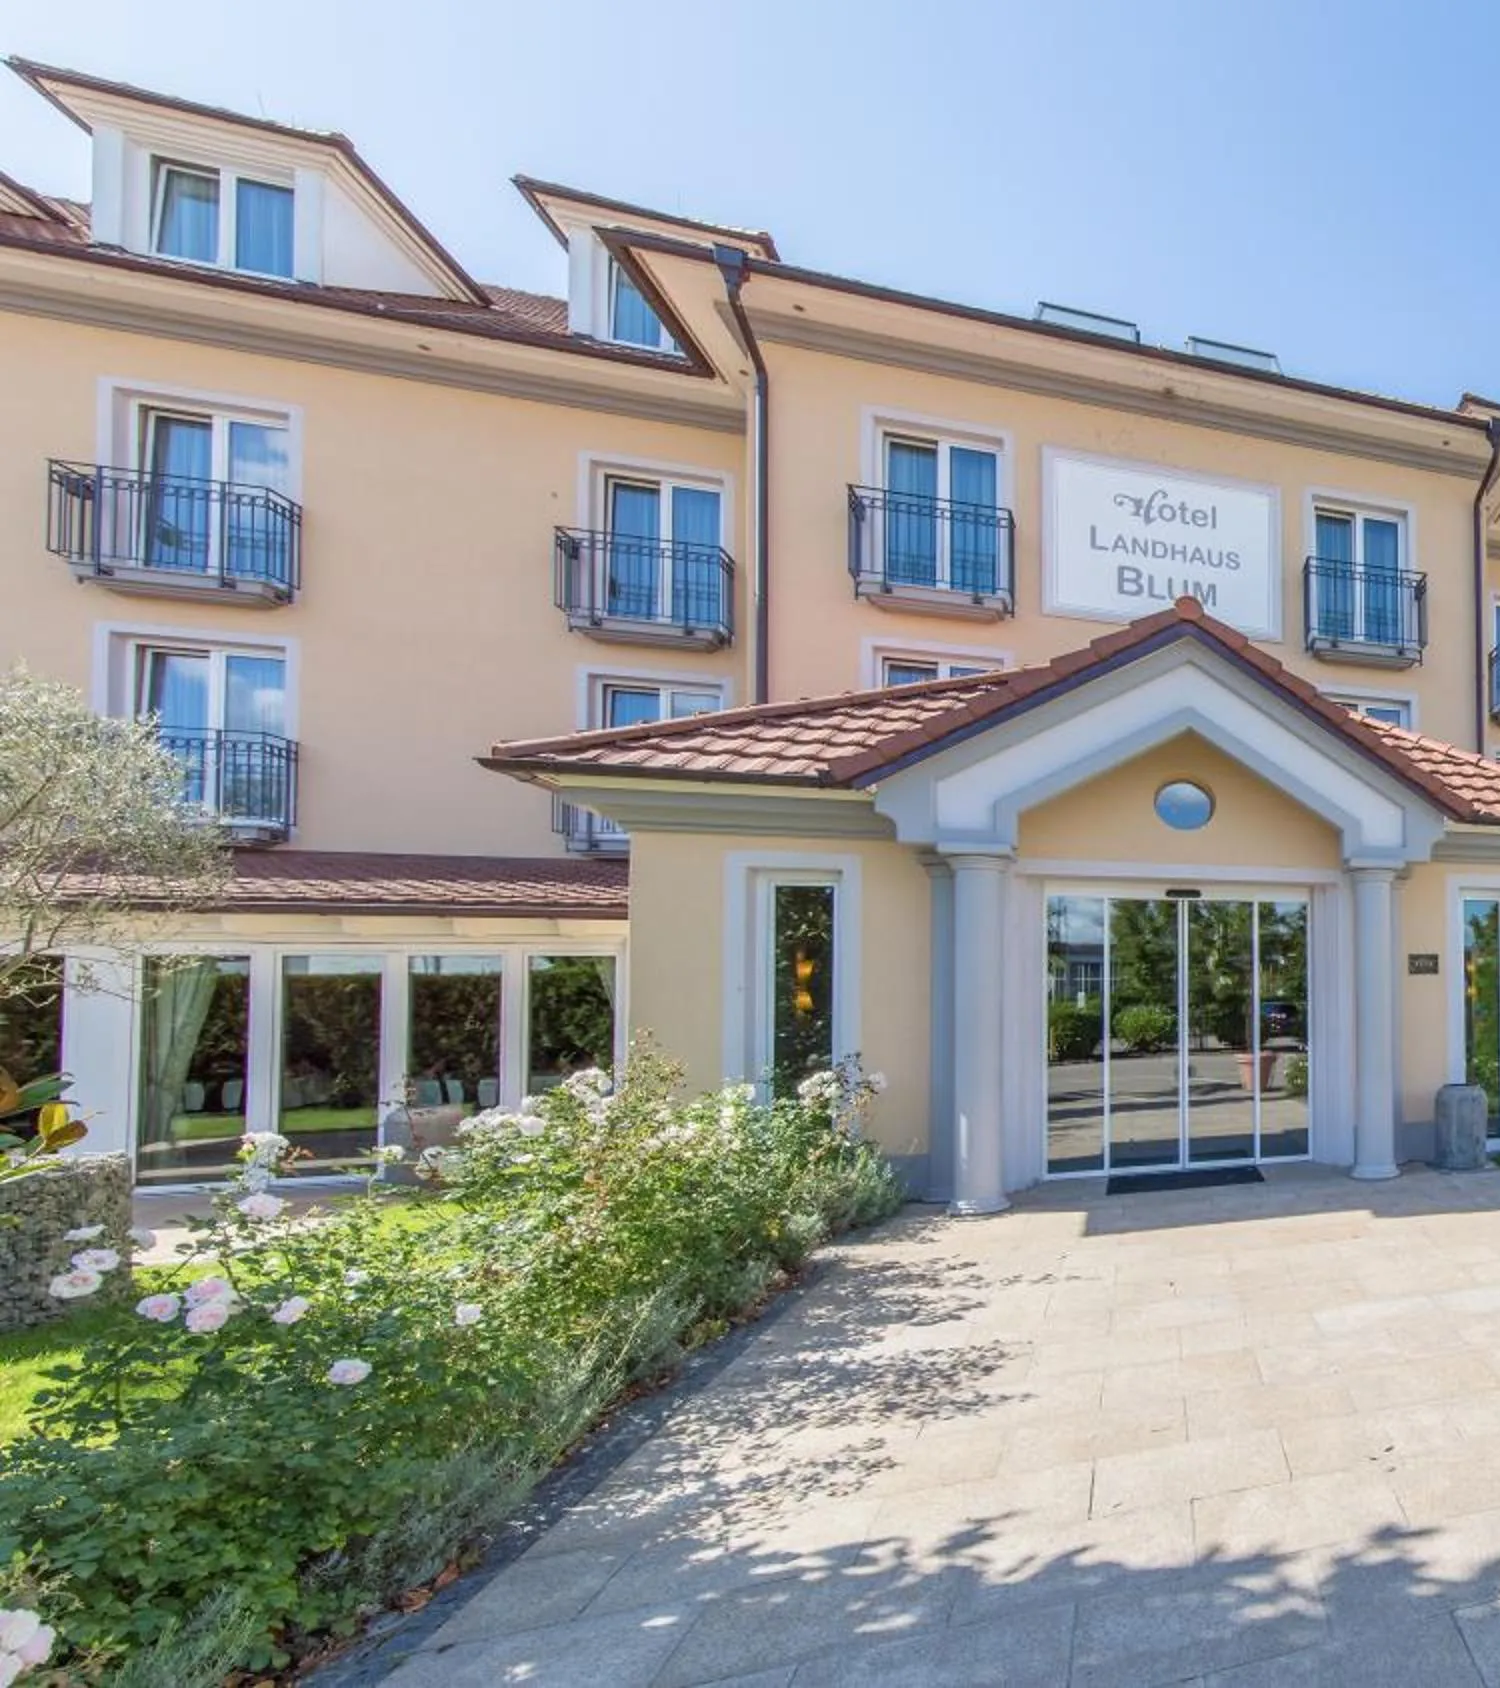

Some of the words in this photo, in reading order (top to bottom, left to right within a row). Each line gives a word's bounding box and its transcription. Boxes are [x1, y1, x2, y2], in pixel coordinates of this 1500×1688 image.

[1113, 489, 1217, 529] Hotel
[1089, 525, 1241, 571] LANDHAUS
[1116, 565, 1217, 607] BLUM
